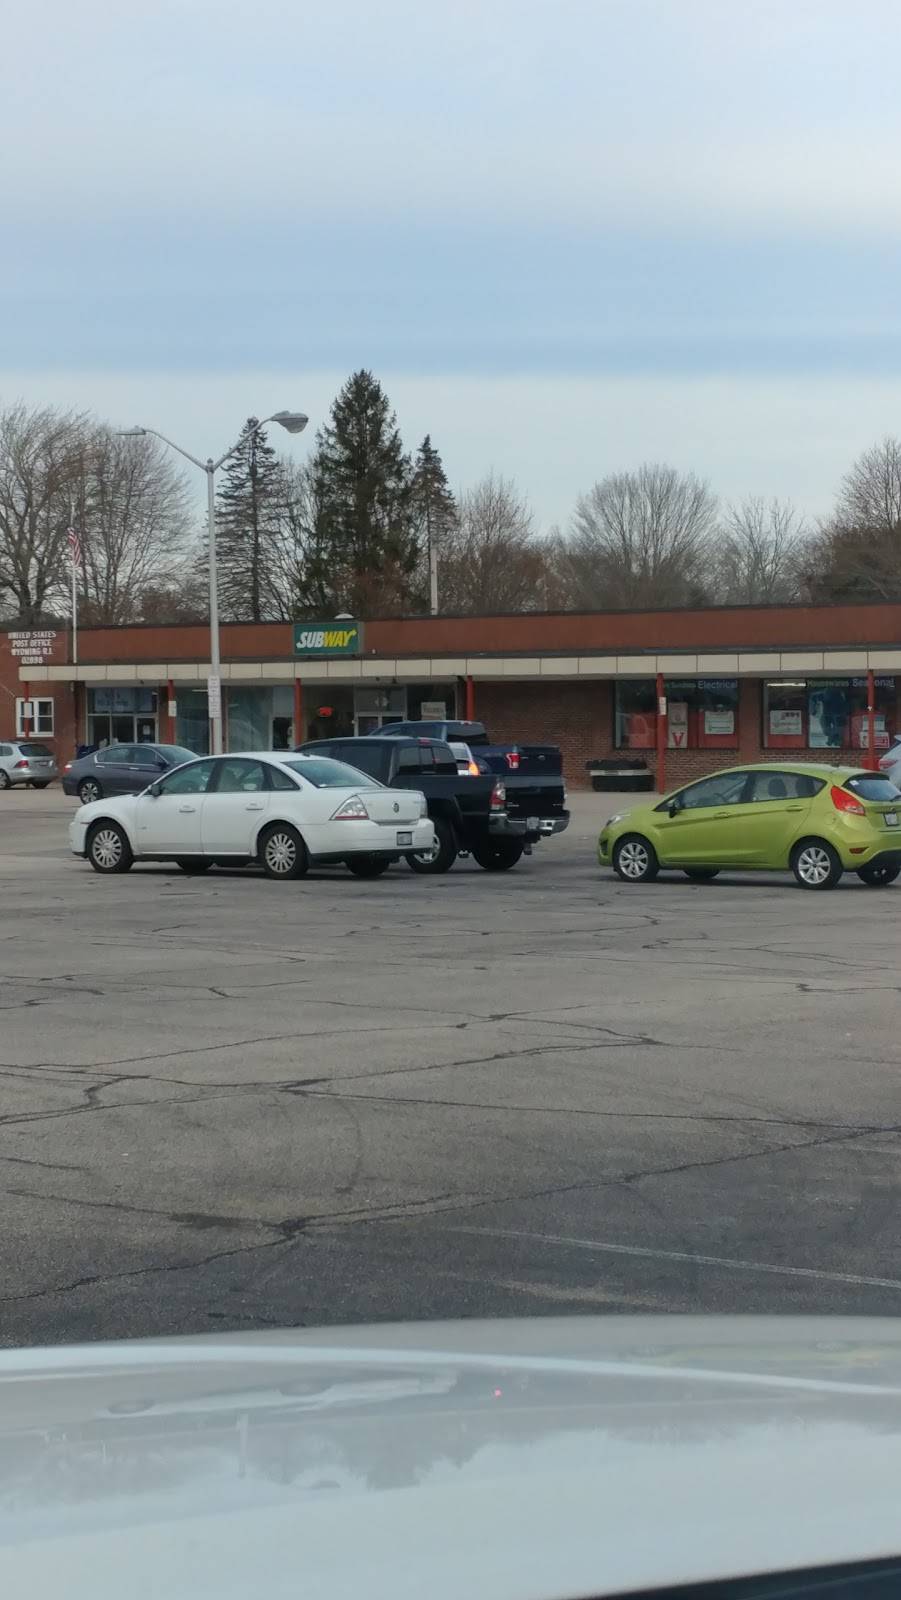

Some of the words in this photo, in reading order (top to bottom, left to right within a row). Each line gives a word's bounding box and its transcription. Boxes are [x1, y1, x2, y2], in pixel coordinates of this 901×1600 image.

[30, 639, 53, 647] OFFICE
[296, 629, 357, 648] SUBWAY
[698, 680, 738, 689] Electrical
